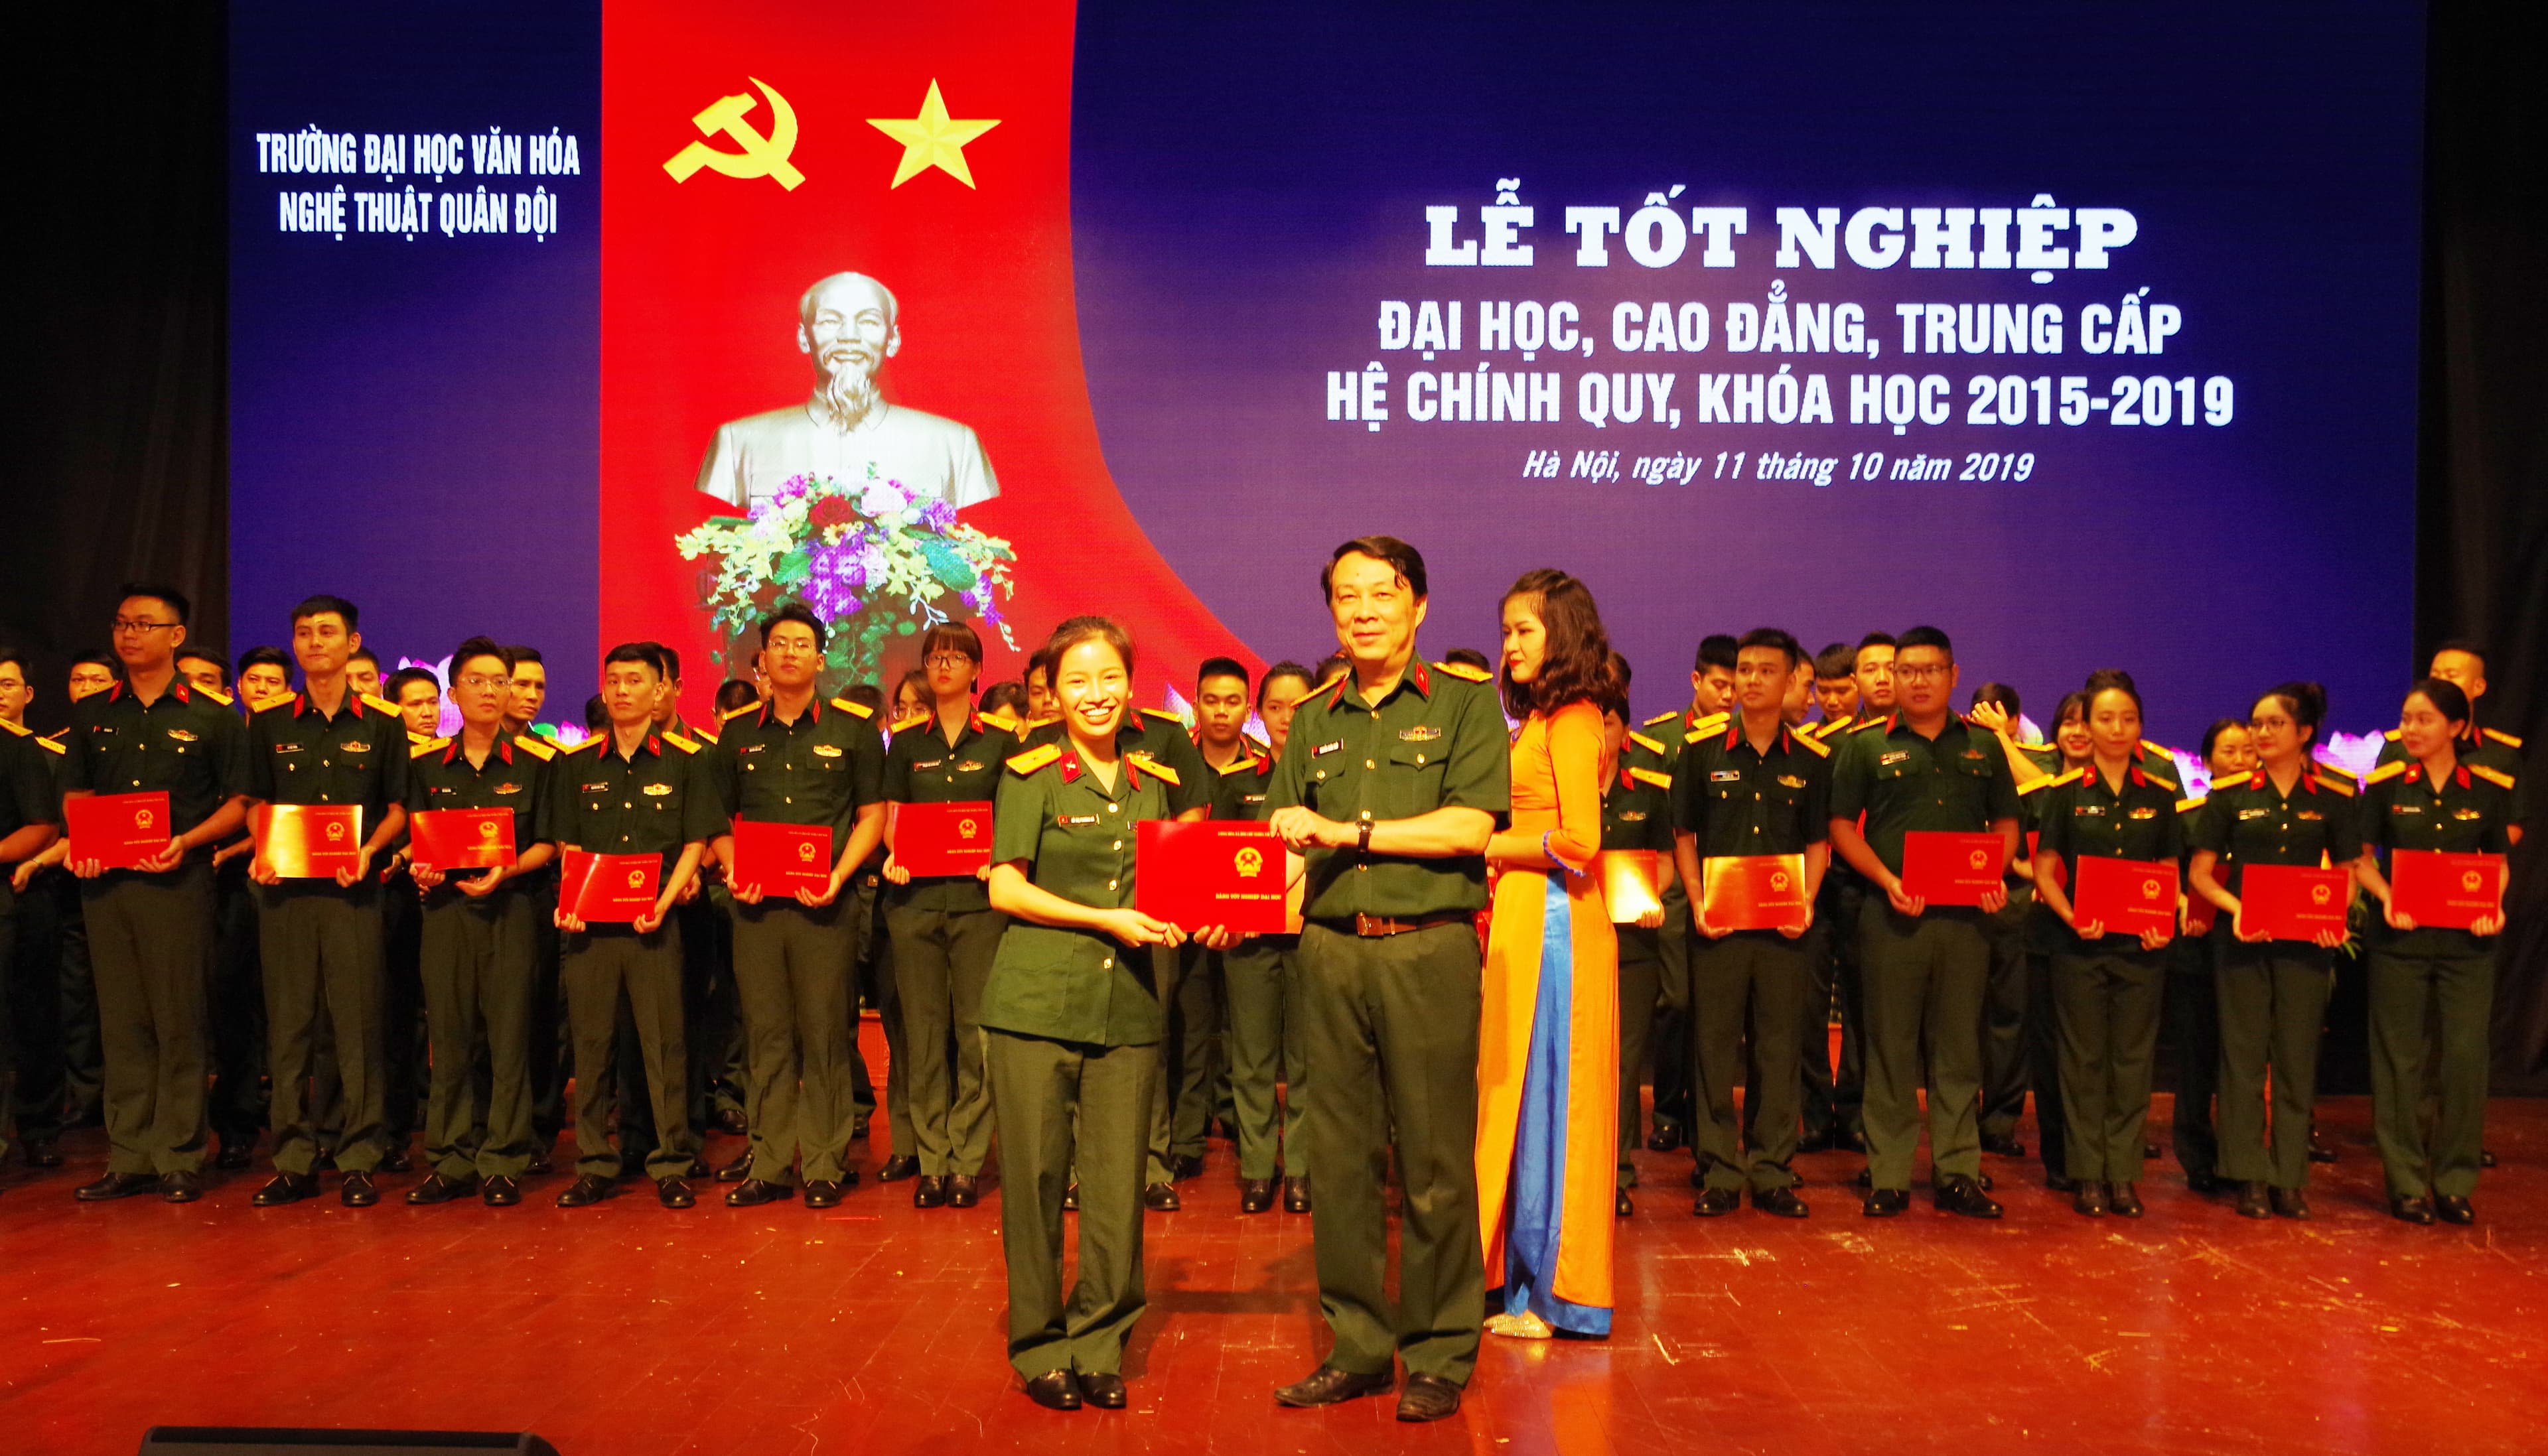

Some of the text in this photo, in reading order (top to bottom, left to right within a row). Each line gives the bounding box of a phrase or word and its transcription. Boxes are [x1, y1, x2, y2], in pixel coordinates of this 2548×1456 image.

[256, 123, 581, 183] TRƯỜNG ĐẠI HỌC VĂN HÓA
[280, 184, 557, 243] NGHỆ THUẬT QUÂN ĐỘI
[1425, 178, 2138, 284] LỄ TỐT NGHIỆP
[1378, 279, 2182, 361] ĐẠI HỌC, CAO ĐẲNG, TRUNG CẤP
[1327, 362, 2233, 435] HỆ CHÍNH QUY, KHÓA HỌC 2015-2019
[1522, 450, 2035, 488] Hà Nội, ngày 11 tháng 10 năm 2019
